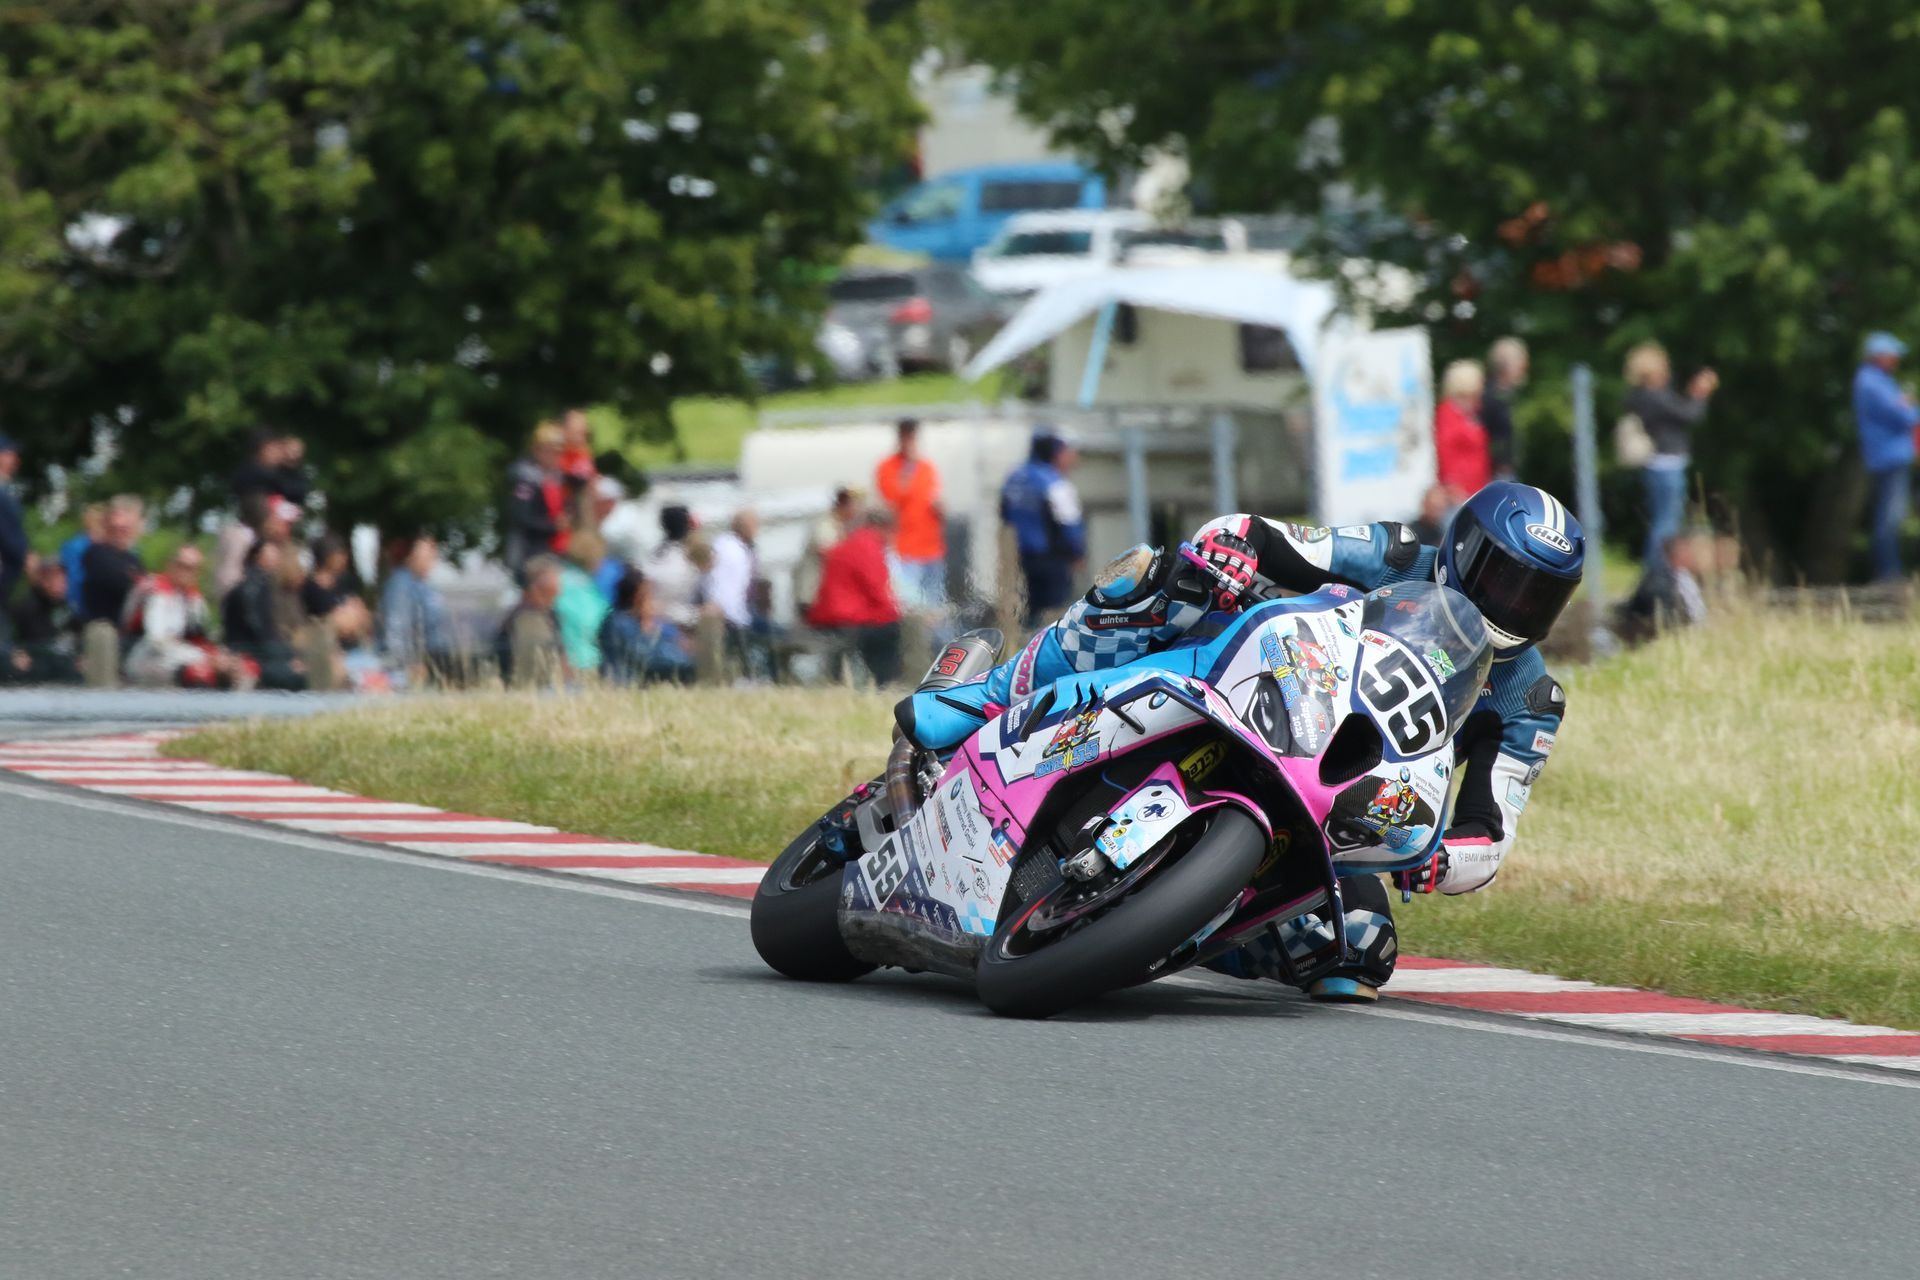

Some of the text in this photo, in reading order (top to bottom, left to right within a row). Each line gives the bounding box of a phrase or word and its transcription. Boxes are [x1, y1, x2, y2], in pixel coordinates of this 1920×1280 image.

[1533, 527, 1569, 551] HJC
[1099, 615, 1130, 625] wintex
[1359, 648, 1446, 754] 55
[1292, 715, 1304, 738] 2024
[1300, 702, 1317, 749] Superbike
[1072, 737, 1099, 767] 55
[866, 838, 904, 904] 55
